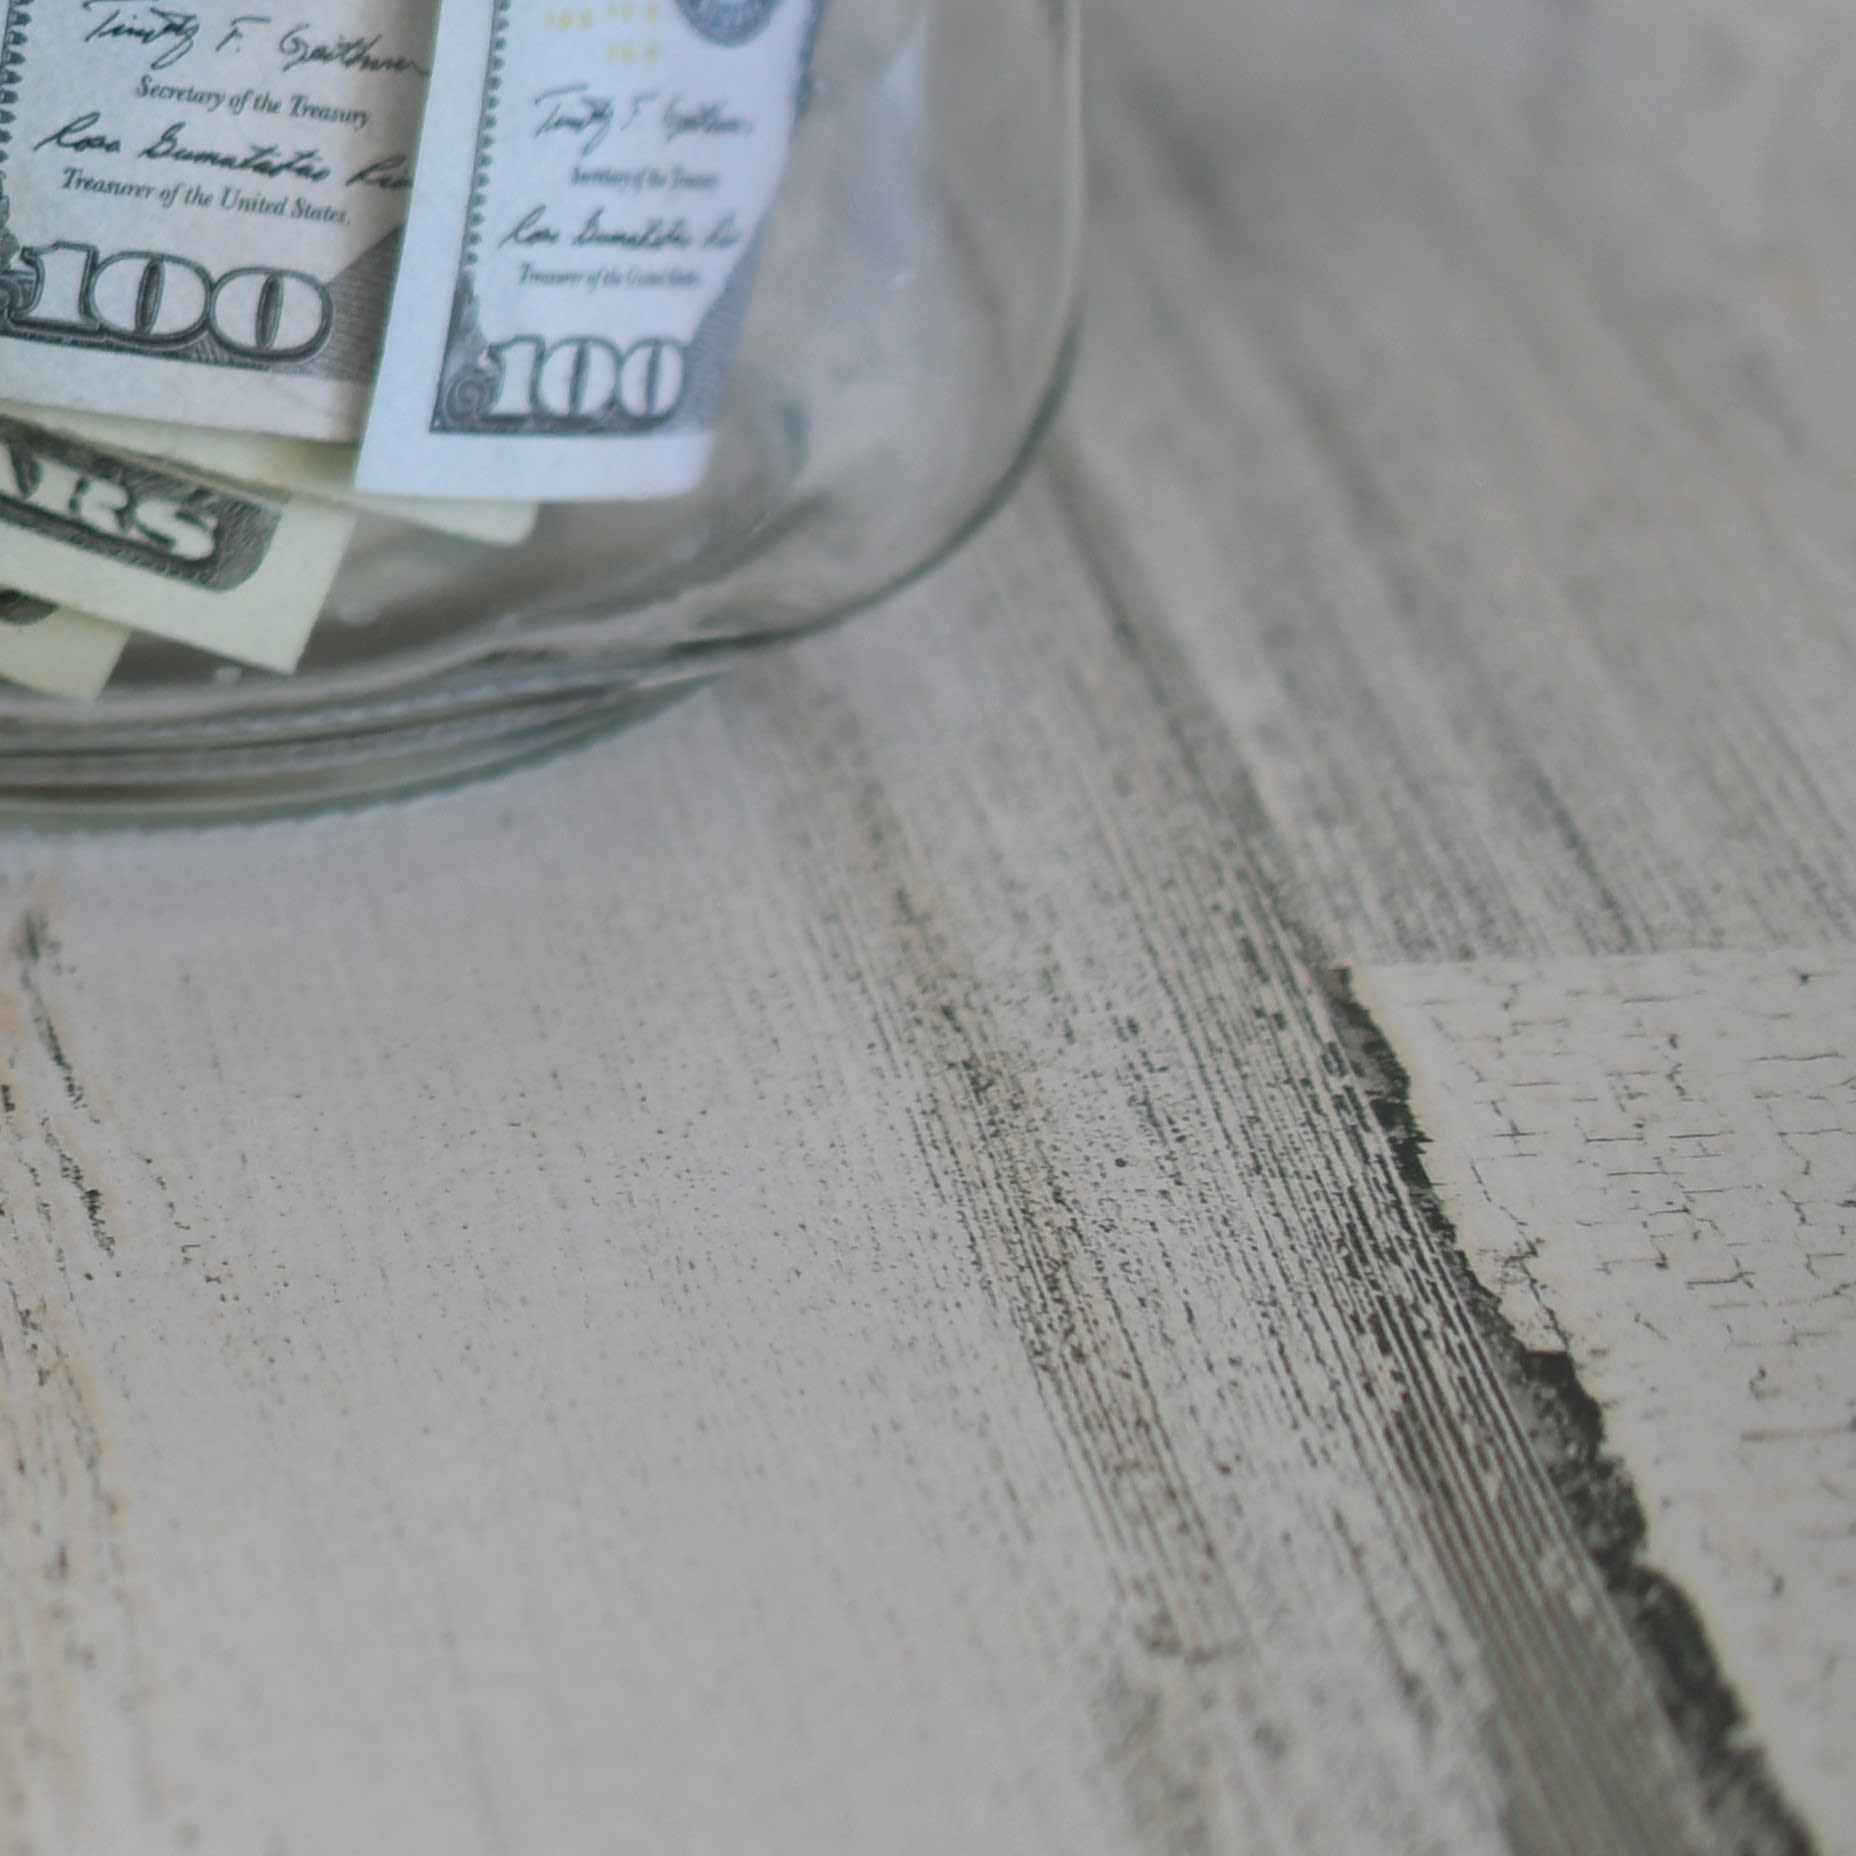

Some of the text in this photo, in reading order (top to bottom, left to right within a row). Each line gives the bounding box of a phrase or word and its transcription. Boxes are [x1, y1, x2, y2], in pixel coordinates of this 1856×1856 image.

[135, 75, 371, 132] Secretary of the Treasury
[61, 166, 154, 200] Treasurer
[159, 182, 186, 209] of
[186, 185, 213, 209] the
[220, 188, 289, 218] United
[3, 240, 331, 364] 100
[490, 335, 690, 425] 100
